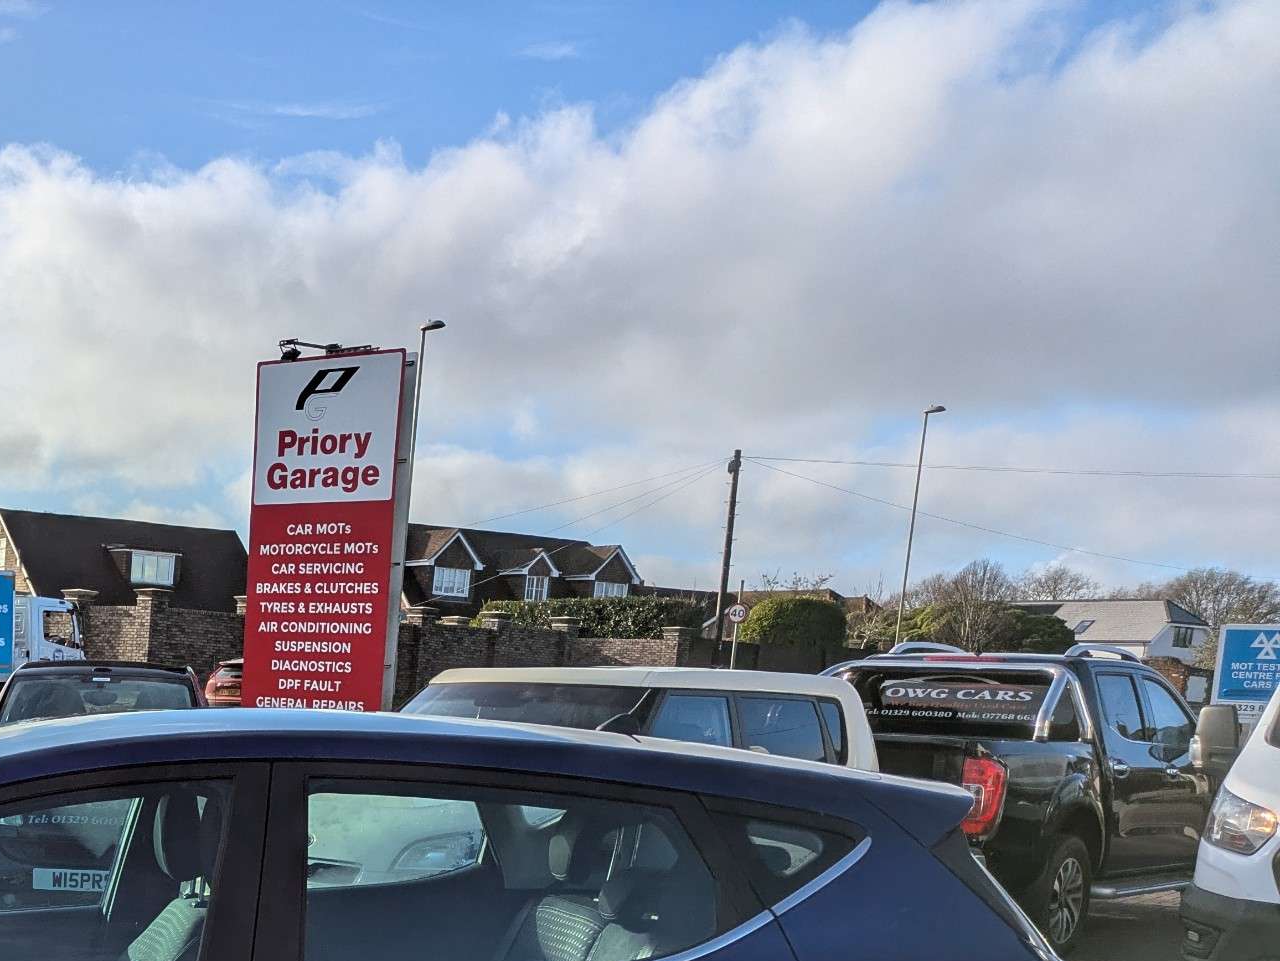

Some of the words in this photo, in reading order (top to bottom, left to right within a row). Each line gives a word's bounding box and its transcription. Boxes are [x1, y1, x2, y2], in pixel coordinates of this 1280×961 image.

[278, 428, 372, 458] Priory
[267, 462, 380, 492] Garage
[286, 524, 313, 536] CAR
[316, 523, 352, 534] MOTs
[260, 543, 341, 555] MOTORCYCLE
[344, 543, 379, 554] MOTs
[271, 563, 296, 575] CAR
[299, 562, 364, 574] SERVICING
[256, 583, 301, 594] BRAKES
[304, 583, 312, 594] &
[315, 583, 379, 594] CLUTCHES
[260, 602, 295, 613] TYRES
[298, 602, 306, 613] &
[309, 603, 373, 614] EXHAUSTS
[730, 608, 745, 618] 40
[258, 622, 278, 632] AIR
[281, 622, 372, 634] CONDITIONING
[275, 641, 351, 653] SUSPENSION
[271, 660, 352, 673] DIAGNOSTICS
[1231, 662, 1255, 670] MOT
[1231, 671, 1273, 680] CENTRE
[278, 678, 301, 690] DPF
[304, 680, 342, 692] FAULT
[885, 687, 949, 699] OWG
[957, 690, 1034, 701] CARS
[256, 696, 307, 708] GENERAL
[28, 814, 49, 824] Tel:
